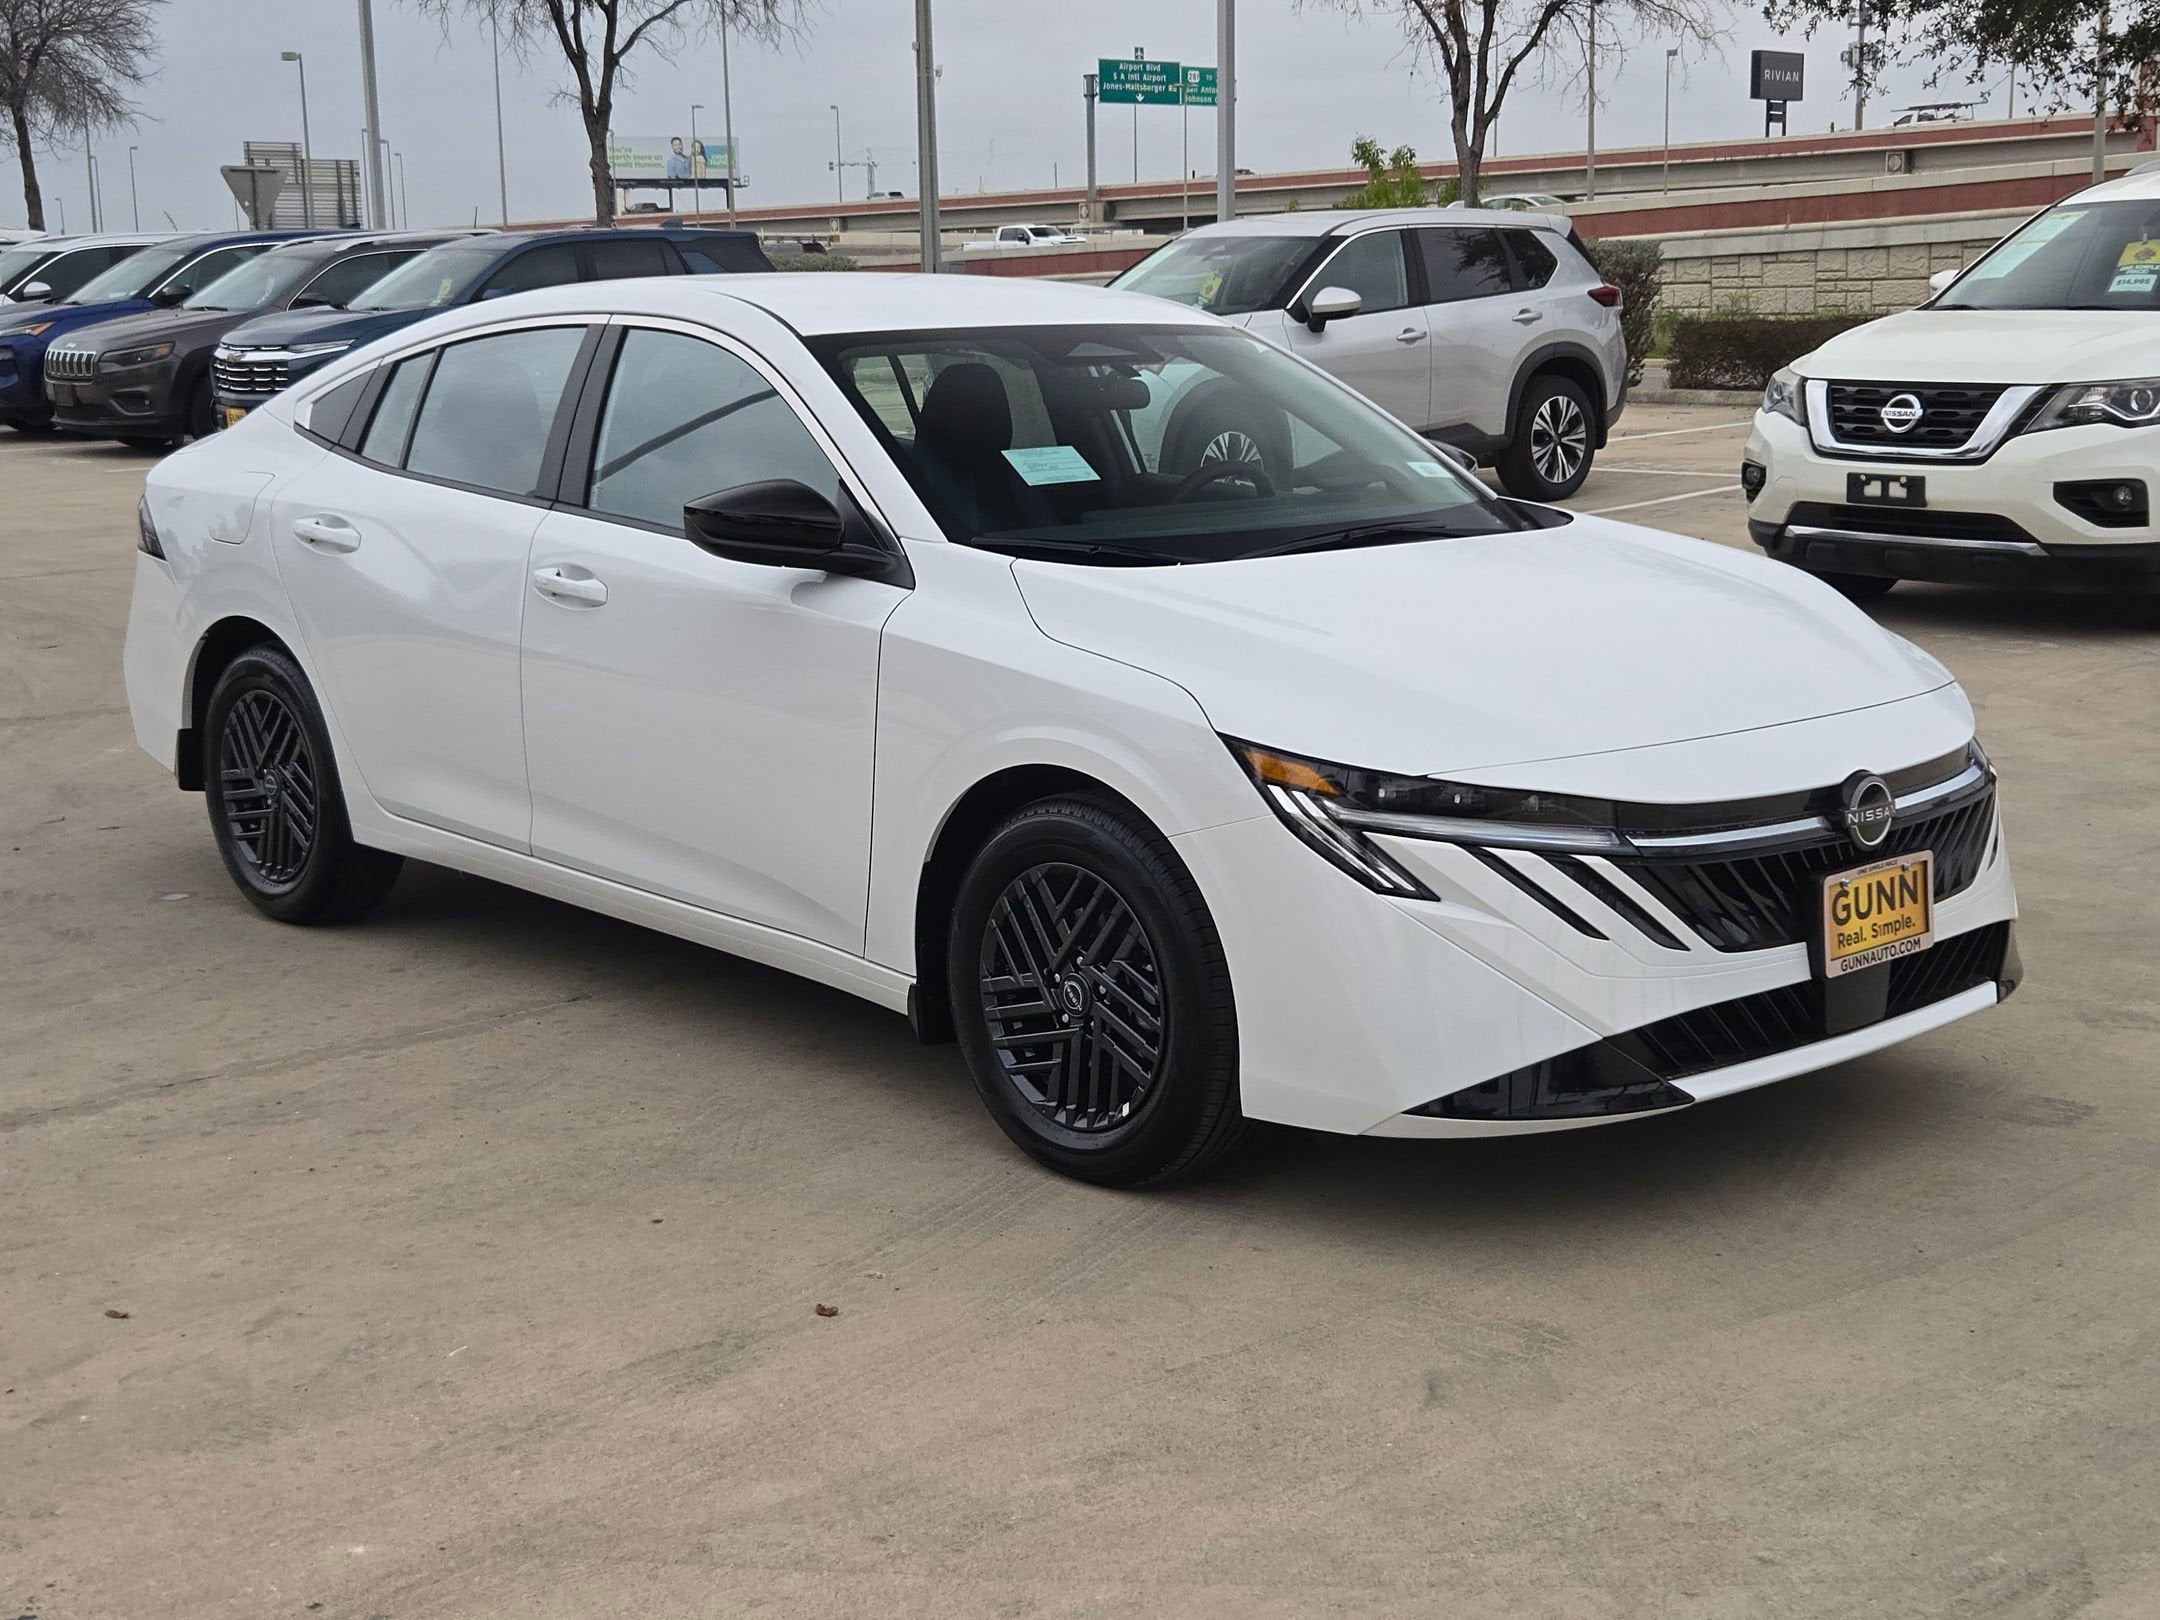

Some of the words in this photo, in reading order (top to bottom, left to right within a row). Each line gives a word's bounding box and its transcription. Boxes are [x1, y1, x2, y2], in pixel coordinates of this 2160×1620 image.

[1113, 72, 1118, 80] S
[1120, 72, 1125, 80] A
[1142, 74, 1167, 83] Airport
[1119, 63, 1143, 72] Airport
[1146, 63, 1161, 72] Blvd
[1764, 69, 1799, 82] RIVIAN
[1847, 803, 1896, 825] NISSAN
[1831, 870, 1919, 926] GUNN
[1836, 926, 1867, 950] Real.
[1871, 915, 1916, 938] Simple.
[1840, 937, 1921, 972] GUNNAUTO.COM
